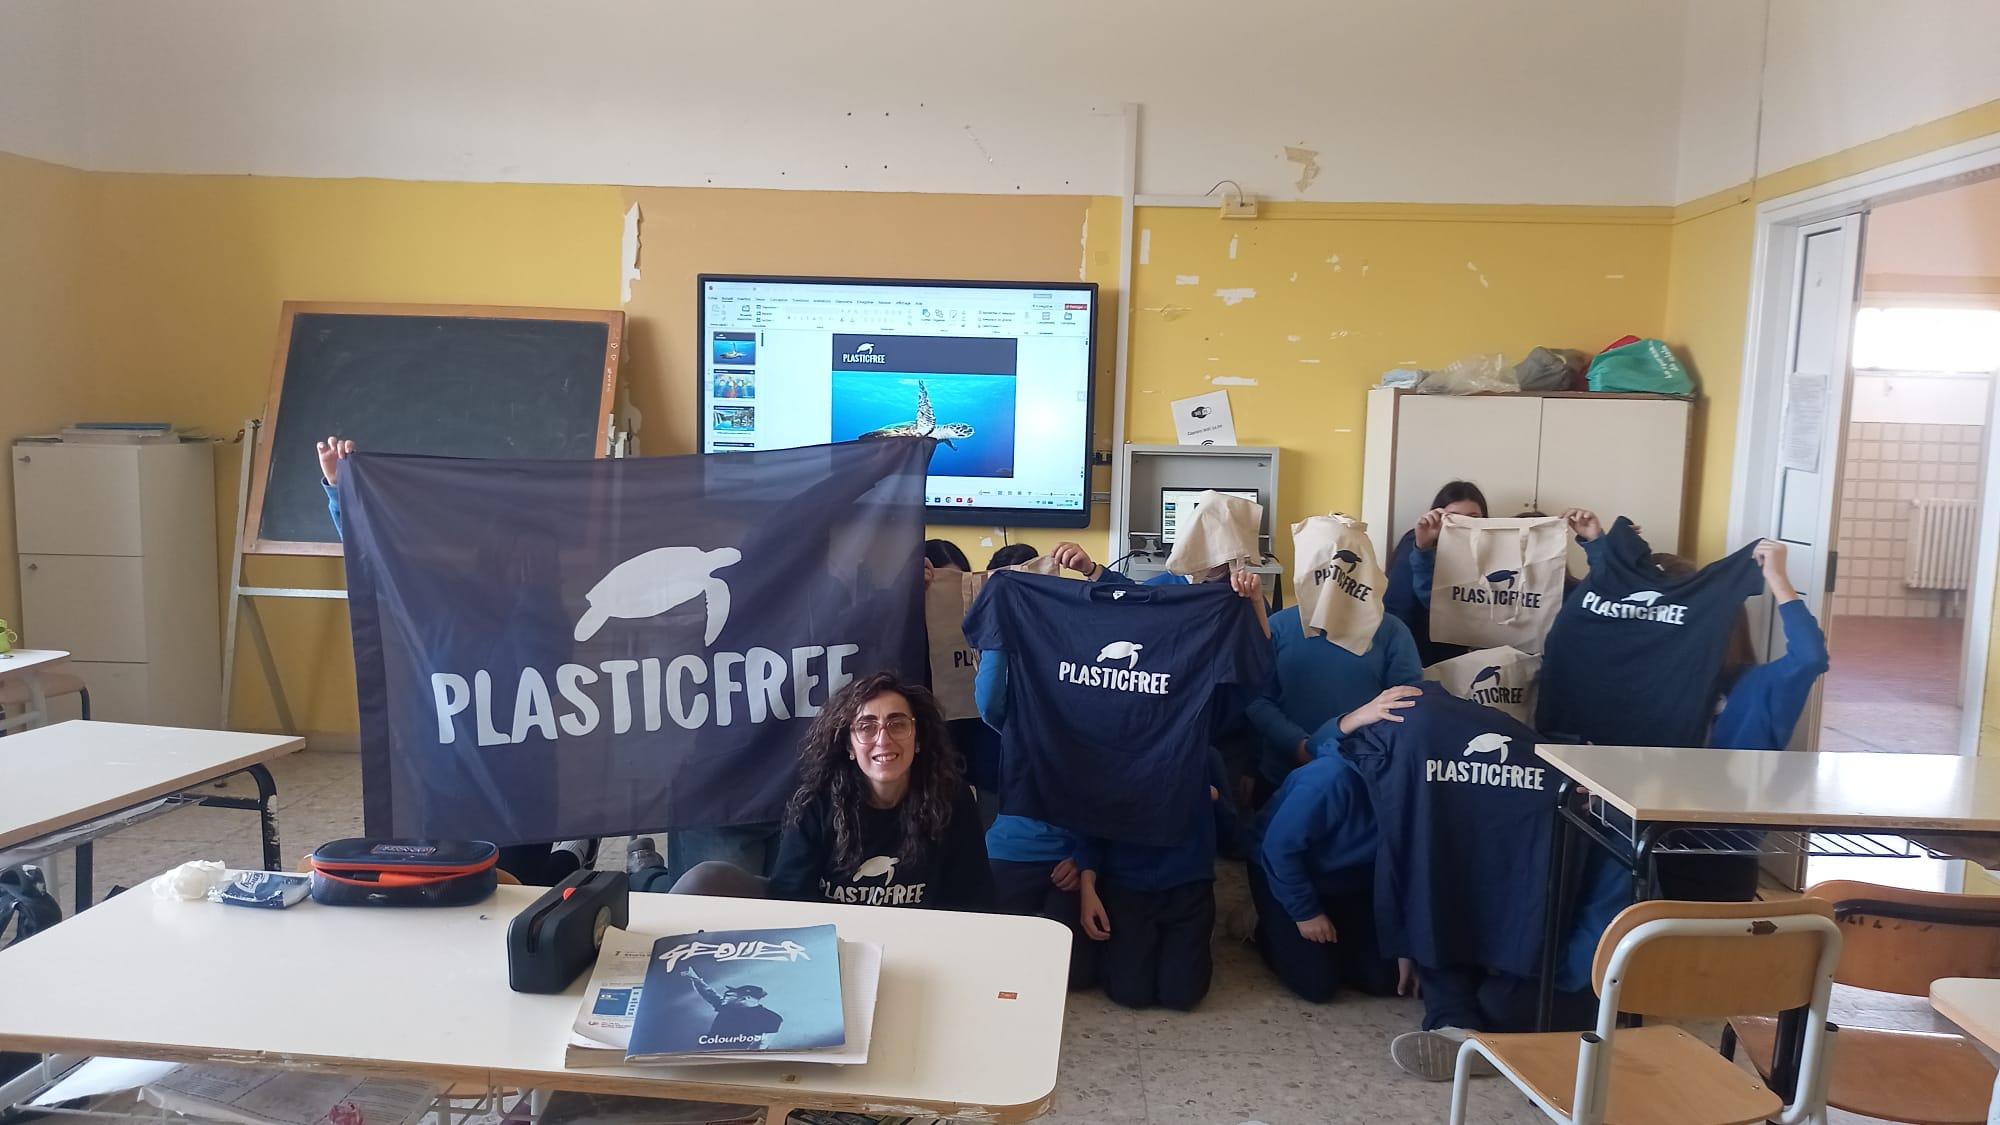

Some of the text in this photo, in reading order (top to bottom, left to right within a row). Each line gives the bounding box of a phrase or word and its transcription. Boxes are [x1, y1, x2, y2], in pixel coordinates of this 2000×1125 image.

[842, 353, 886, 364] PLASTICFREE
[1582, 591, 1688, 625] PLASTICFREE
[1058, 660, 1171, 695] PLASTICFREE
[1426, 759, 1545, 791] PLASTICFREE
